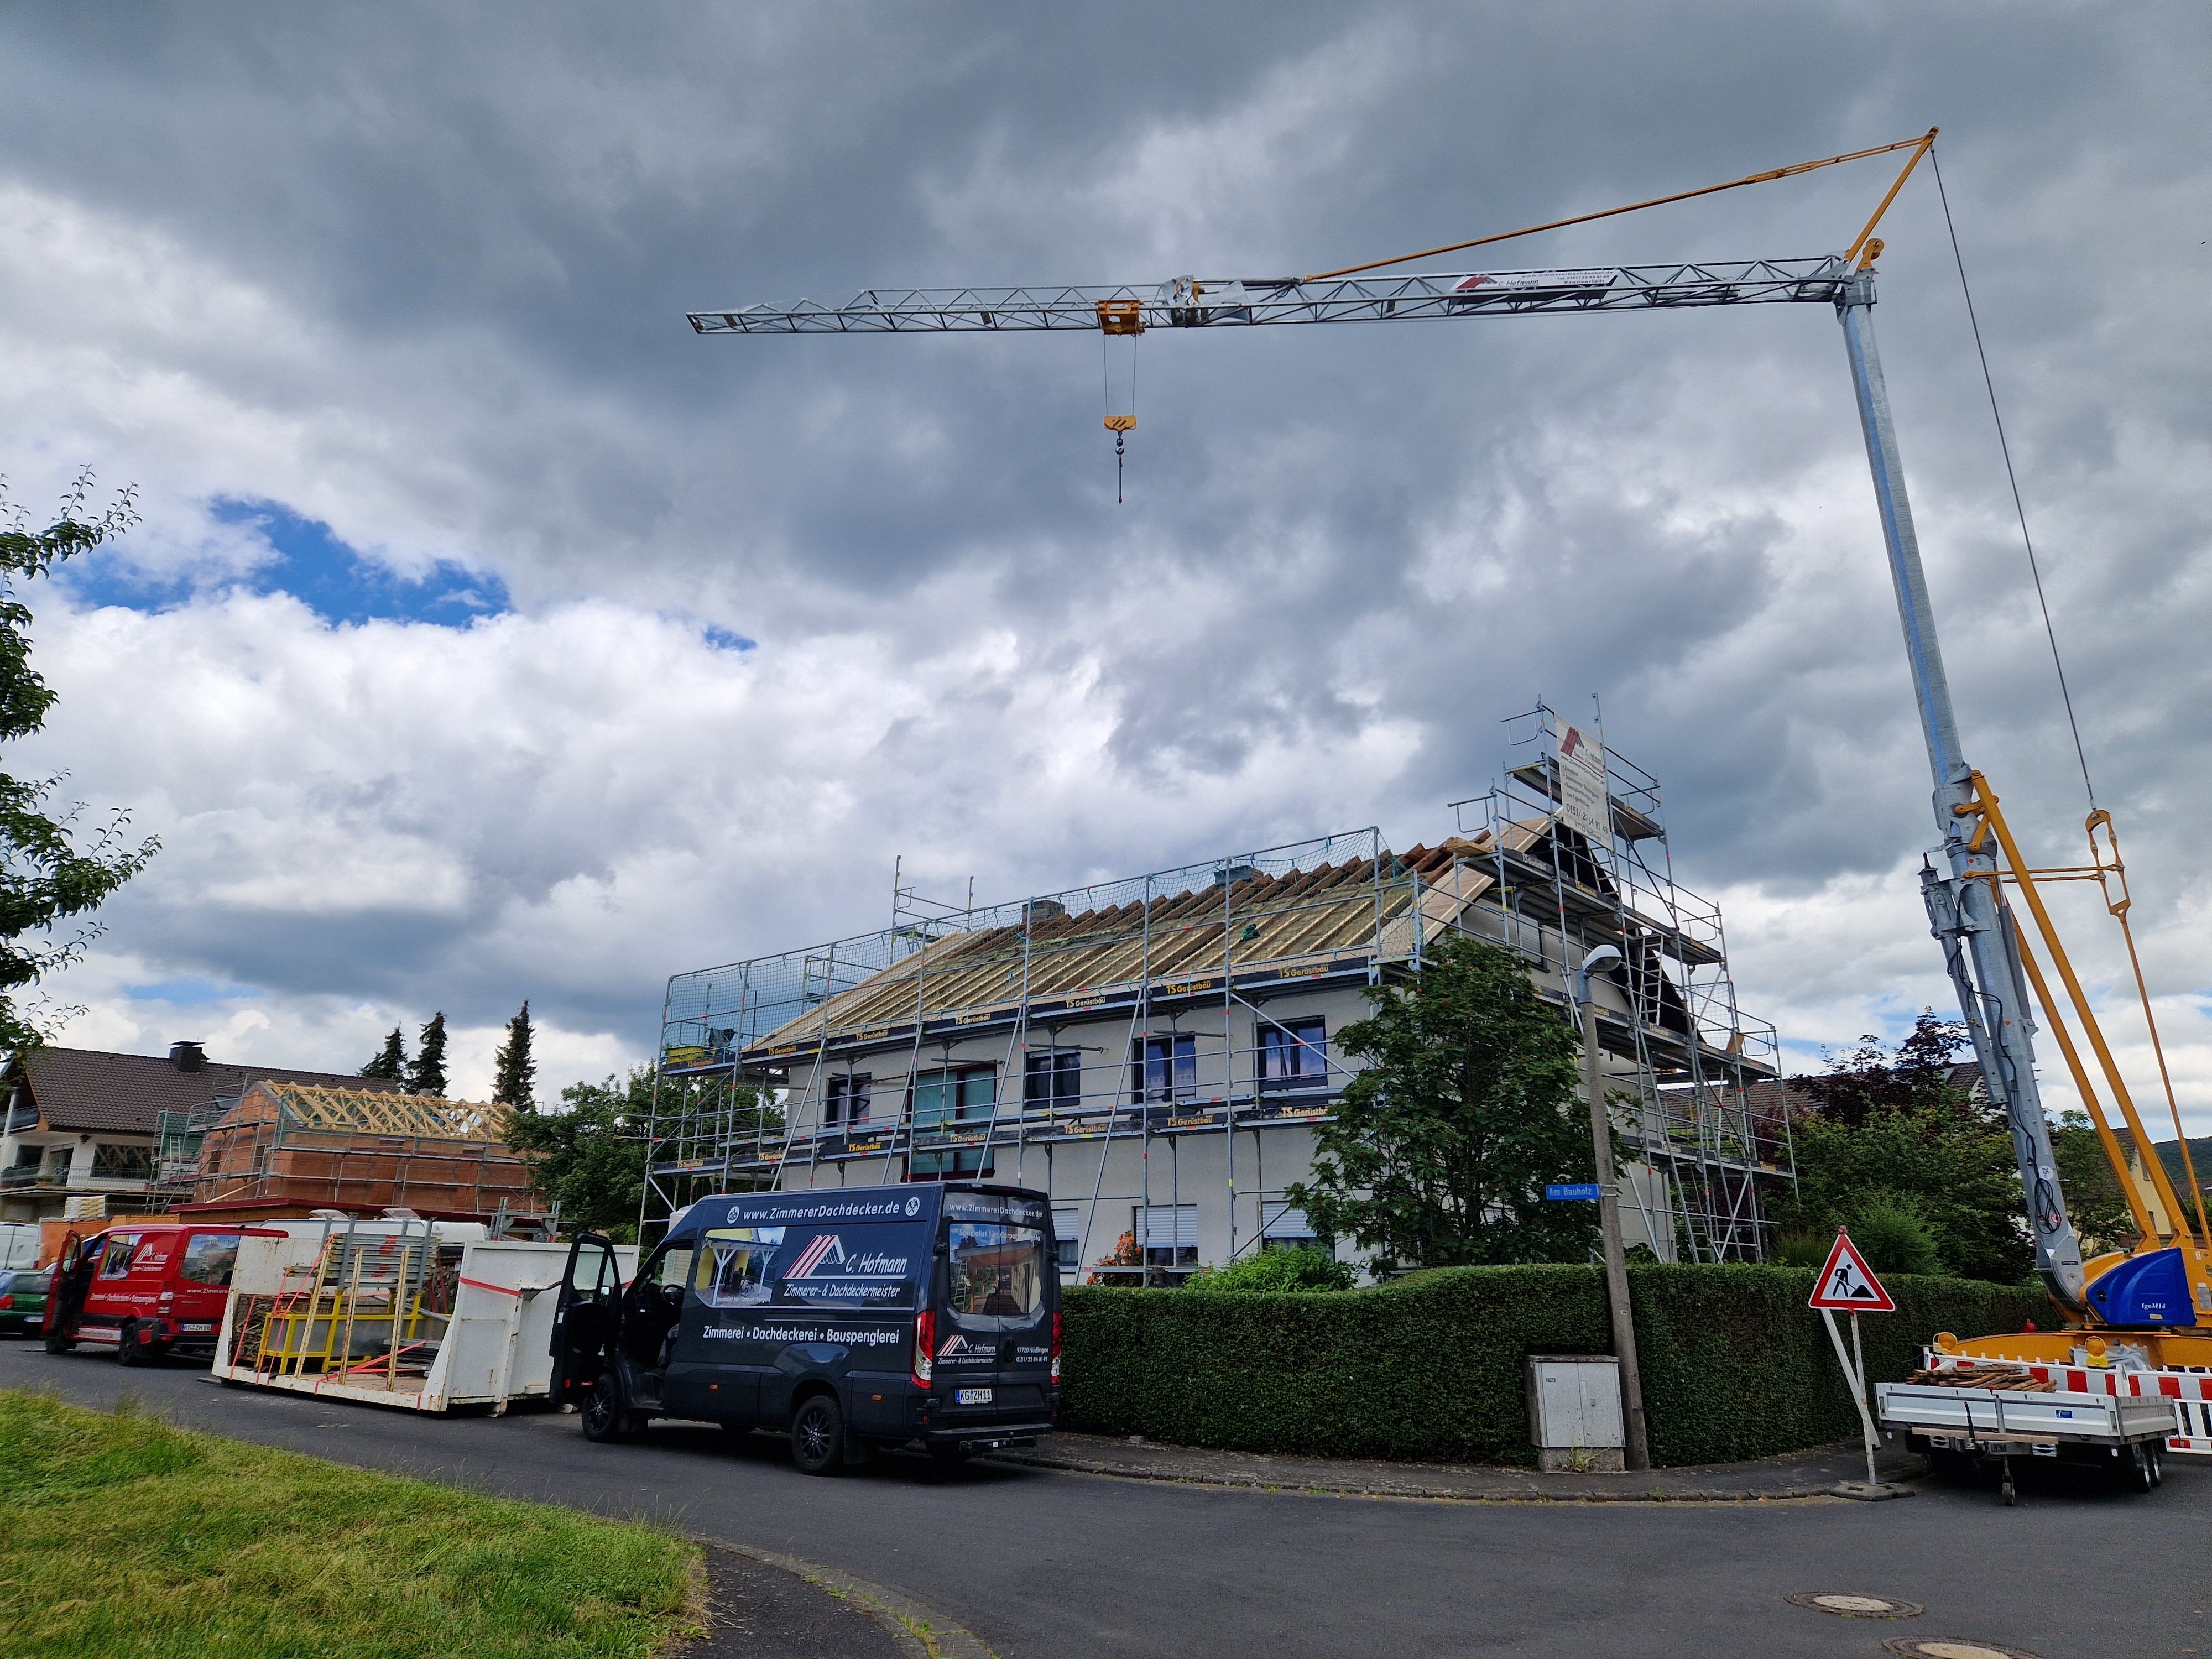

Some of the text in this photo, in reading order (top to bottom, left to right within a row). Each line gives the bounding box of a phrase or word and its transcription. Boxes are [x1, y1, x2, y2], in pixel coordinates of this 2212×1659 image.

[1166, 984, 1176, 994] TS
[1066, 999, 1074, 1008] TS
[955, 1017, 963, 1025] TS
[856, 1032, 863, 1041] TS
[1281, 1107, 1292, 1118] TS
[1167, 1117, 1177, 1126] TS
[1064, 1125, 1073, 1134] TS
[950, 1134, 958, 1143] TS
[848, 1144, 856, 1152] TS
[1549, 1187, 1592, 1196] Am Bauholz
[743, 1201, 900, 1220] www.ZimmererDachdecker.de
[950, 1204, 1042, 1218] www.ZimmererDachdecker.de
[959, 1229, 987, 1237] Spezialist
[846, 1252, 907, 1274] C. Hofmann
[830, 1284, 900, 1298] Dachdeckermeister
[703, 1326, 899, 1347] Zimmerei Dachdeckerei Bauspenglerei
[968, 1344, 995, 1353] C. Hofmann
[961, 1391, 969, 1401] KG
